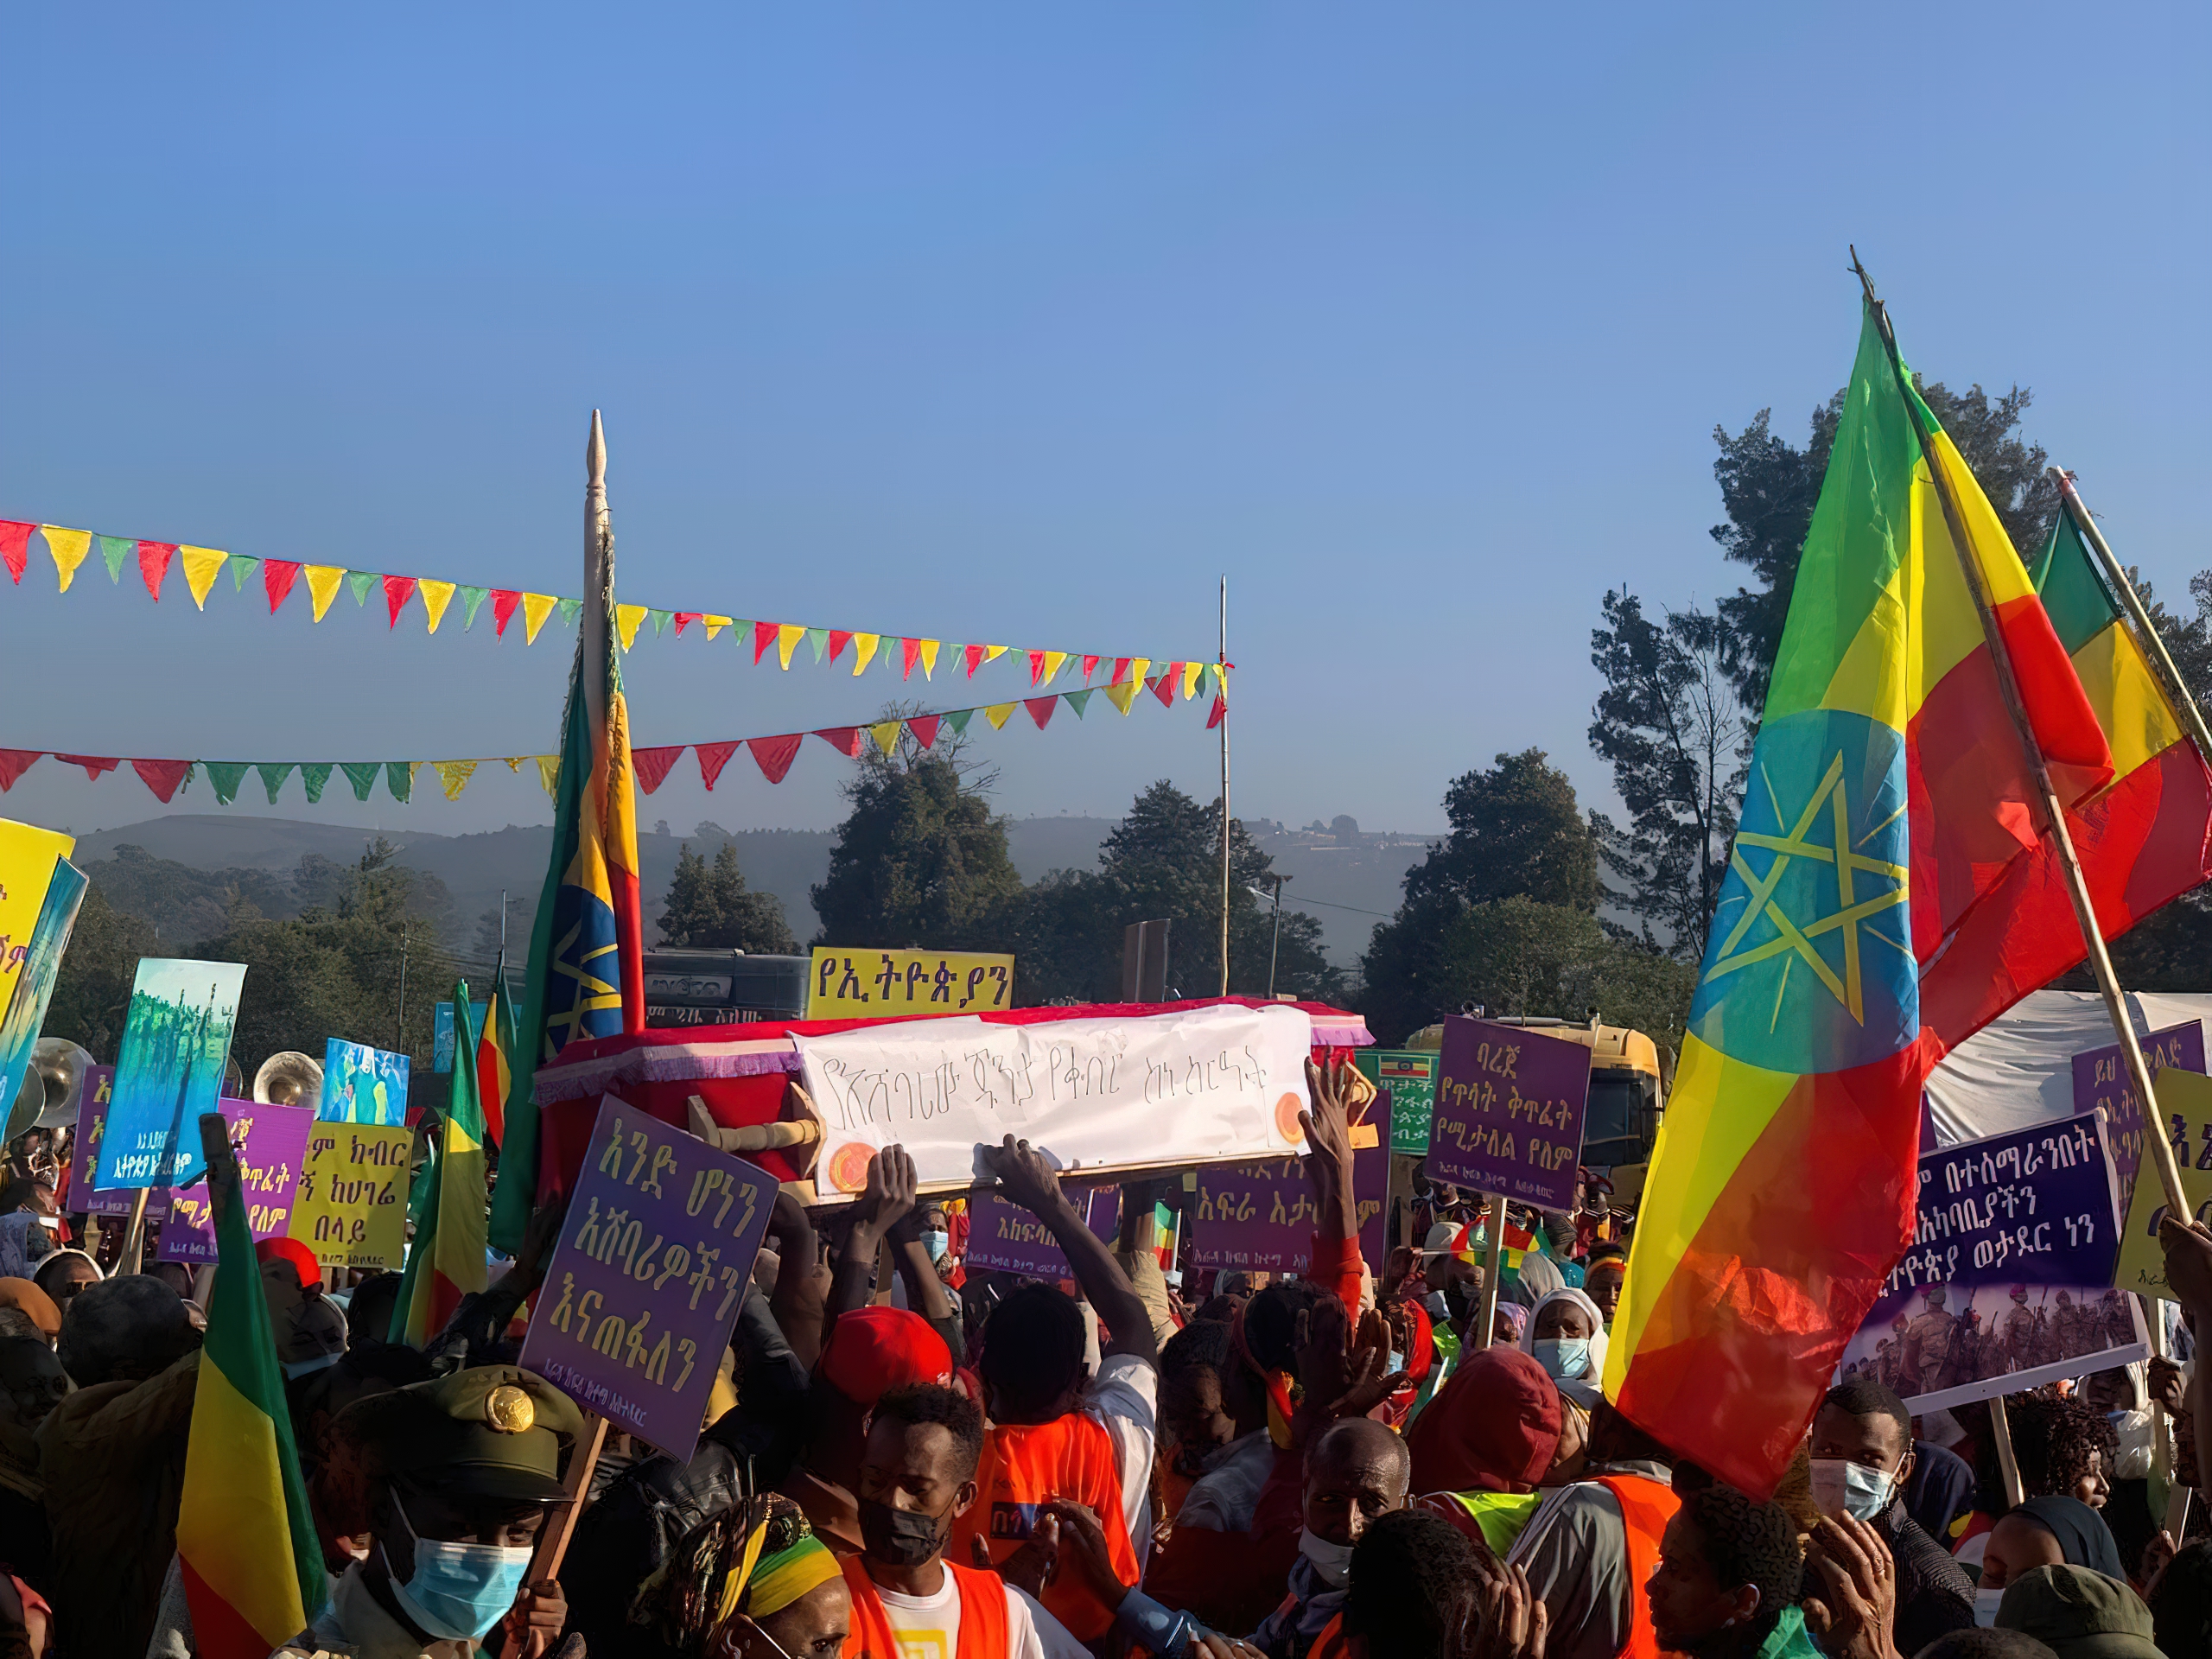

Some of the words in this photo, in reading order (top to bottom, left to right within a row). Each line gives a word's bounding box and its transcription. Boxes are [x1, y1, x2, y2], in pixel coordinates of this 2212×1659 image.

[820, 954, 1008, 1008] የኢትዮጵያን
[599, 1118, 677, 1199] አንድ
[686, 1169, 758, 1238] ሆነን
[1529, 1138, 1573, 1170] የለም
[315, 1215, 365, 1245] በላይ
[1974, 1222, 2051, 1268] ወታደር
[2064, 1213, 2094, 1247] ነን
[550, 1272, 696, 1393] እናጠፋለን
